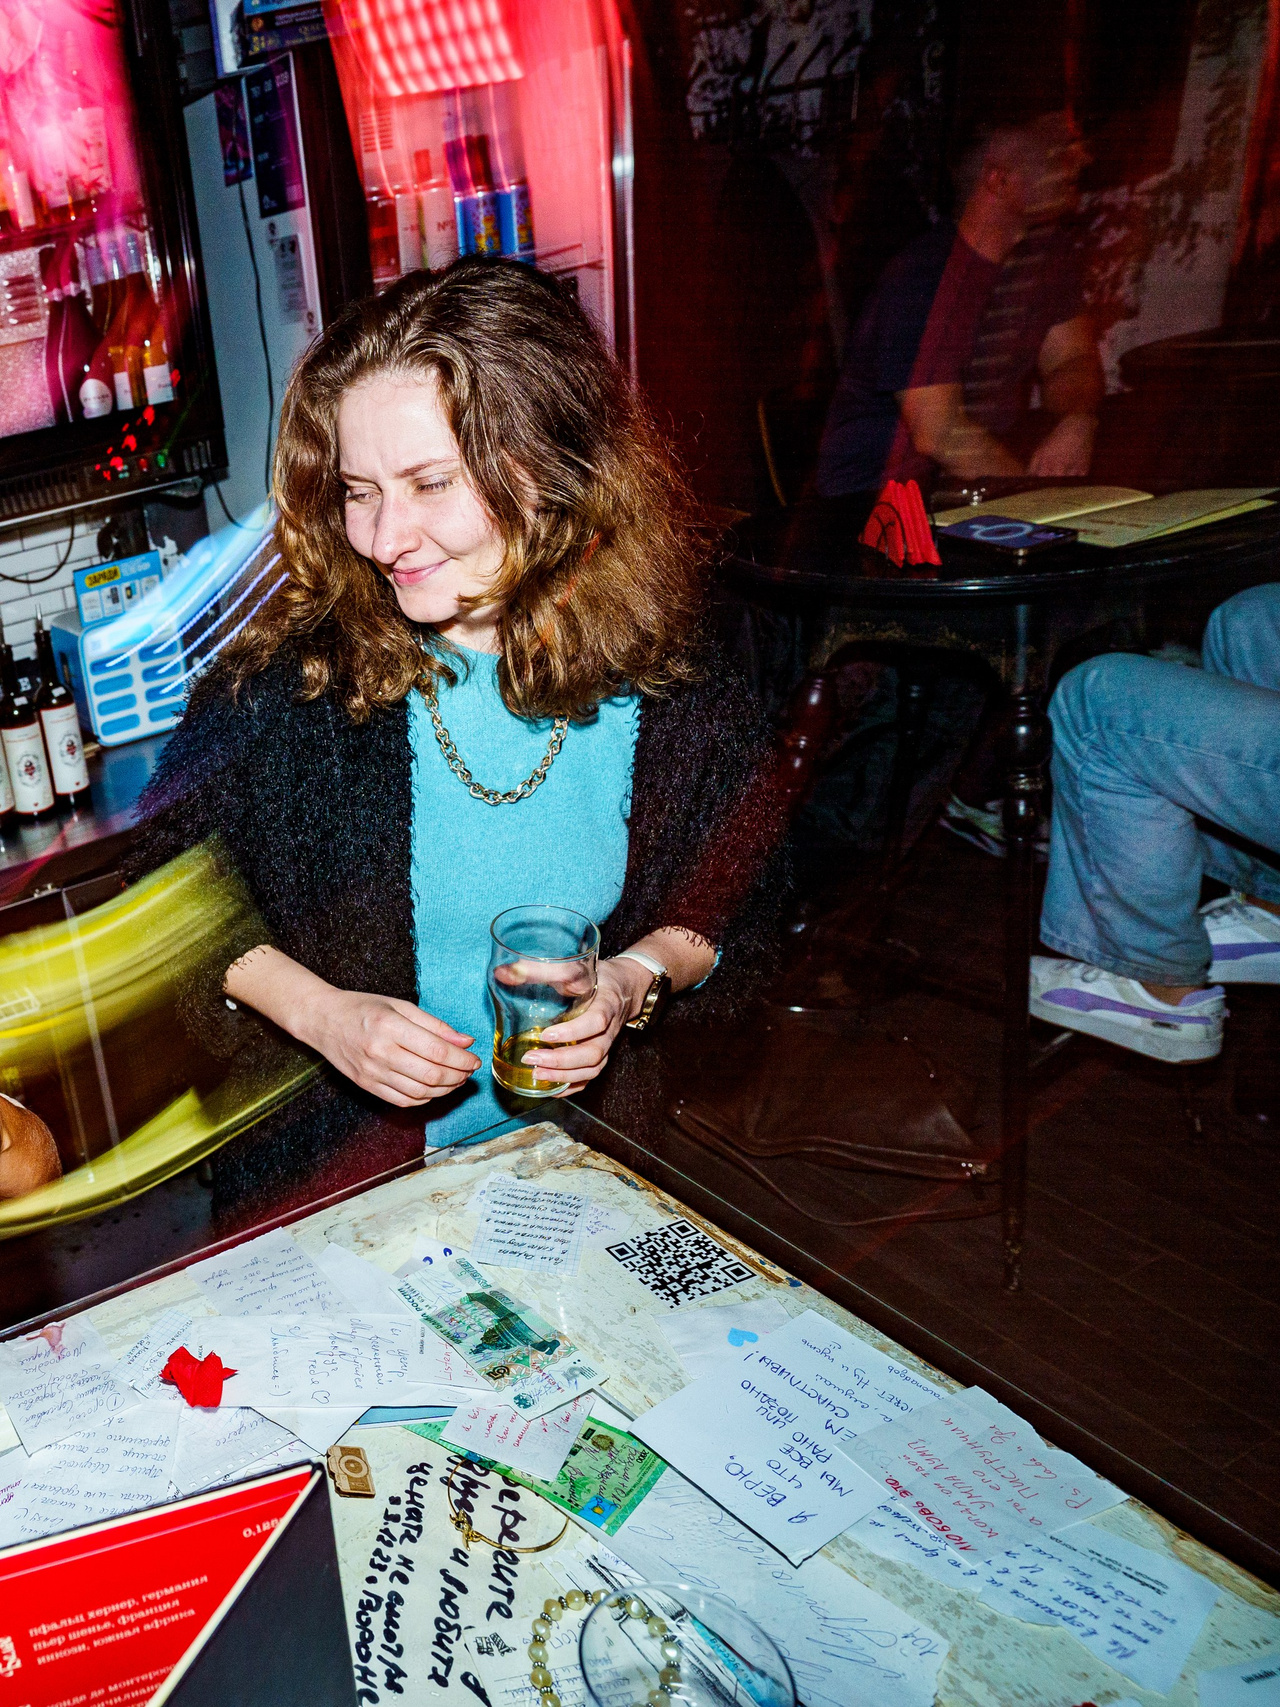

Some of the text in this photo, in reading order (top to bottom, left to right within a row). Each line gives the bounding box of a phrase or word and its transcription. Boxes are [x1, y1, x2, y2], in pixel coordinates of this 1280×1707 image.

[801, 1338, 835, 1363] пусть
[740, 1379, 799, 1424] ПОЗДНО
[743, 1350, 850, 1434] СЧАСТЛИВЫ!
[755, 1405, 833, 1464] РАНО ИЛИ
[724, 1455, 819, 1524] Я ВЕРЮ,
[766, 1459, 803, 1489] ЧТО
[779, 1445, 854, 1498] МЫ ВСЕ
[944, 1475, 995, 1510] УМПА
[912, 1500, 976, 1551] ЛЮБОВЬ
[952, 1499, 999, 1539] КОГДА
[142, 1575, 208, 1602] германия
[30, 1632, 69, 1655] пьер
[117, 1599, 180, 1626] франция
[93, 1627, 140, 1647] южная
[143, 1608, 196, 1631] африка
